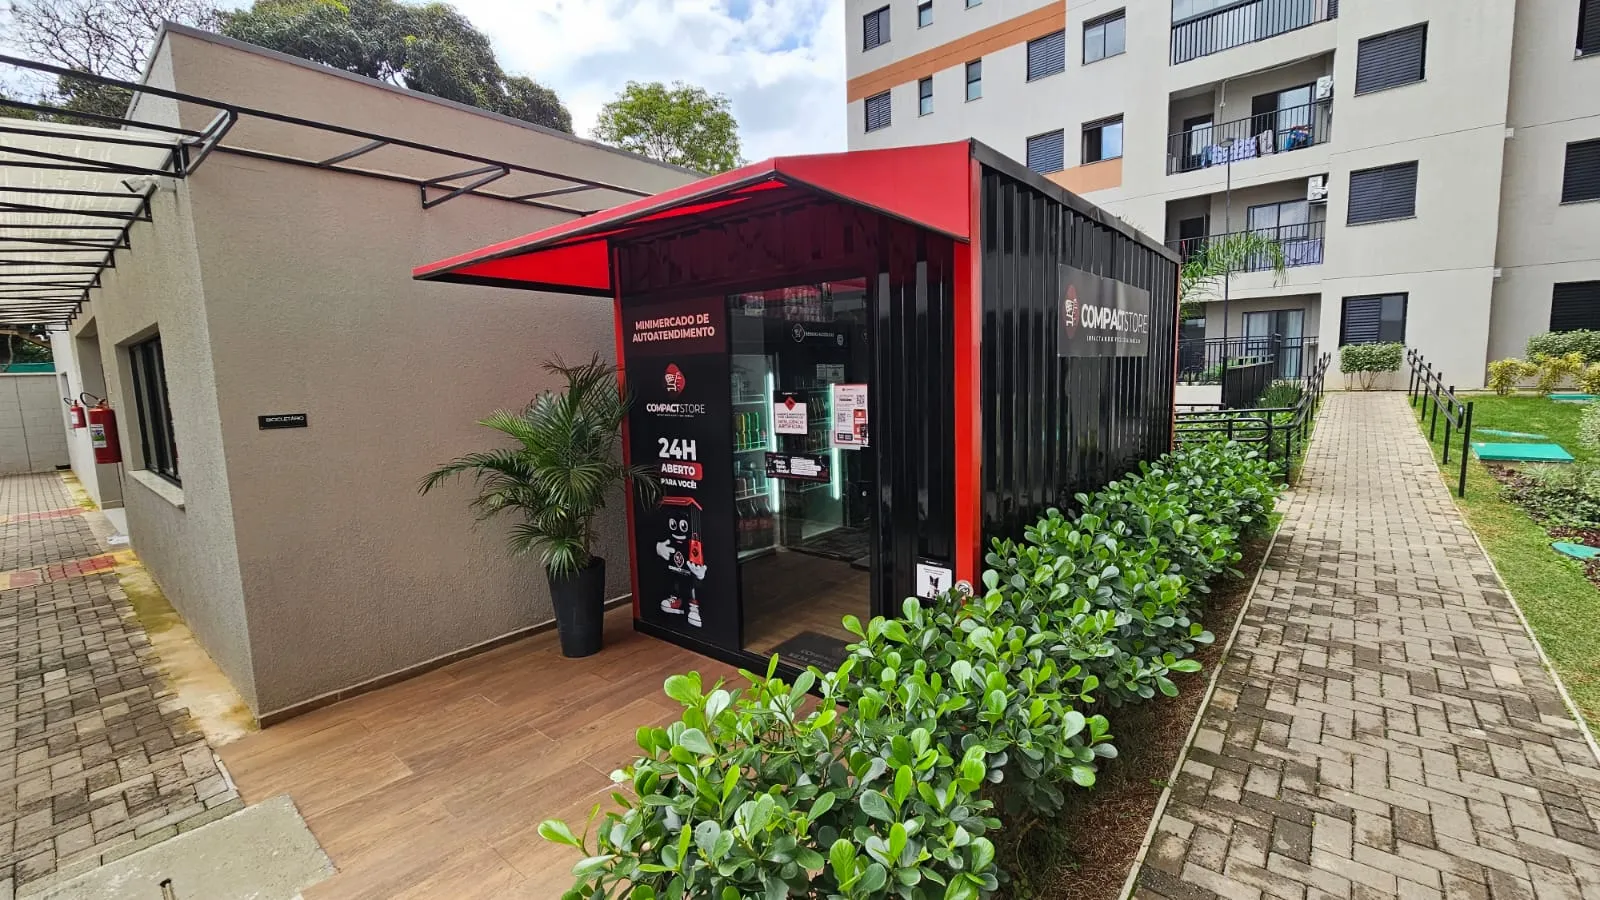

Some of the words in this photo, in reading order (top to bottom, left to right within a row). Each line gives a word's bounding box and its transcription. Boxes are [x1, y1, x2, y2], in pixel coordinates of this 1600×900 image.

[635, 315, 695, 331] MINIMERCADO
[696, 313, 710, 325] DE
[632, 326, 715, 343] AUTOATENDIMENTO
[657, 437, 697, 461] 24H
[661, 463, 696, 476] ABERTO
[660, 478, 678, 487] PARA
